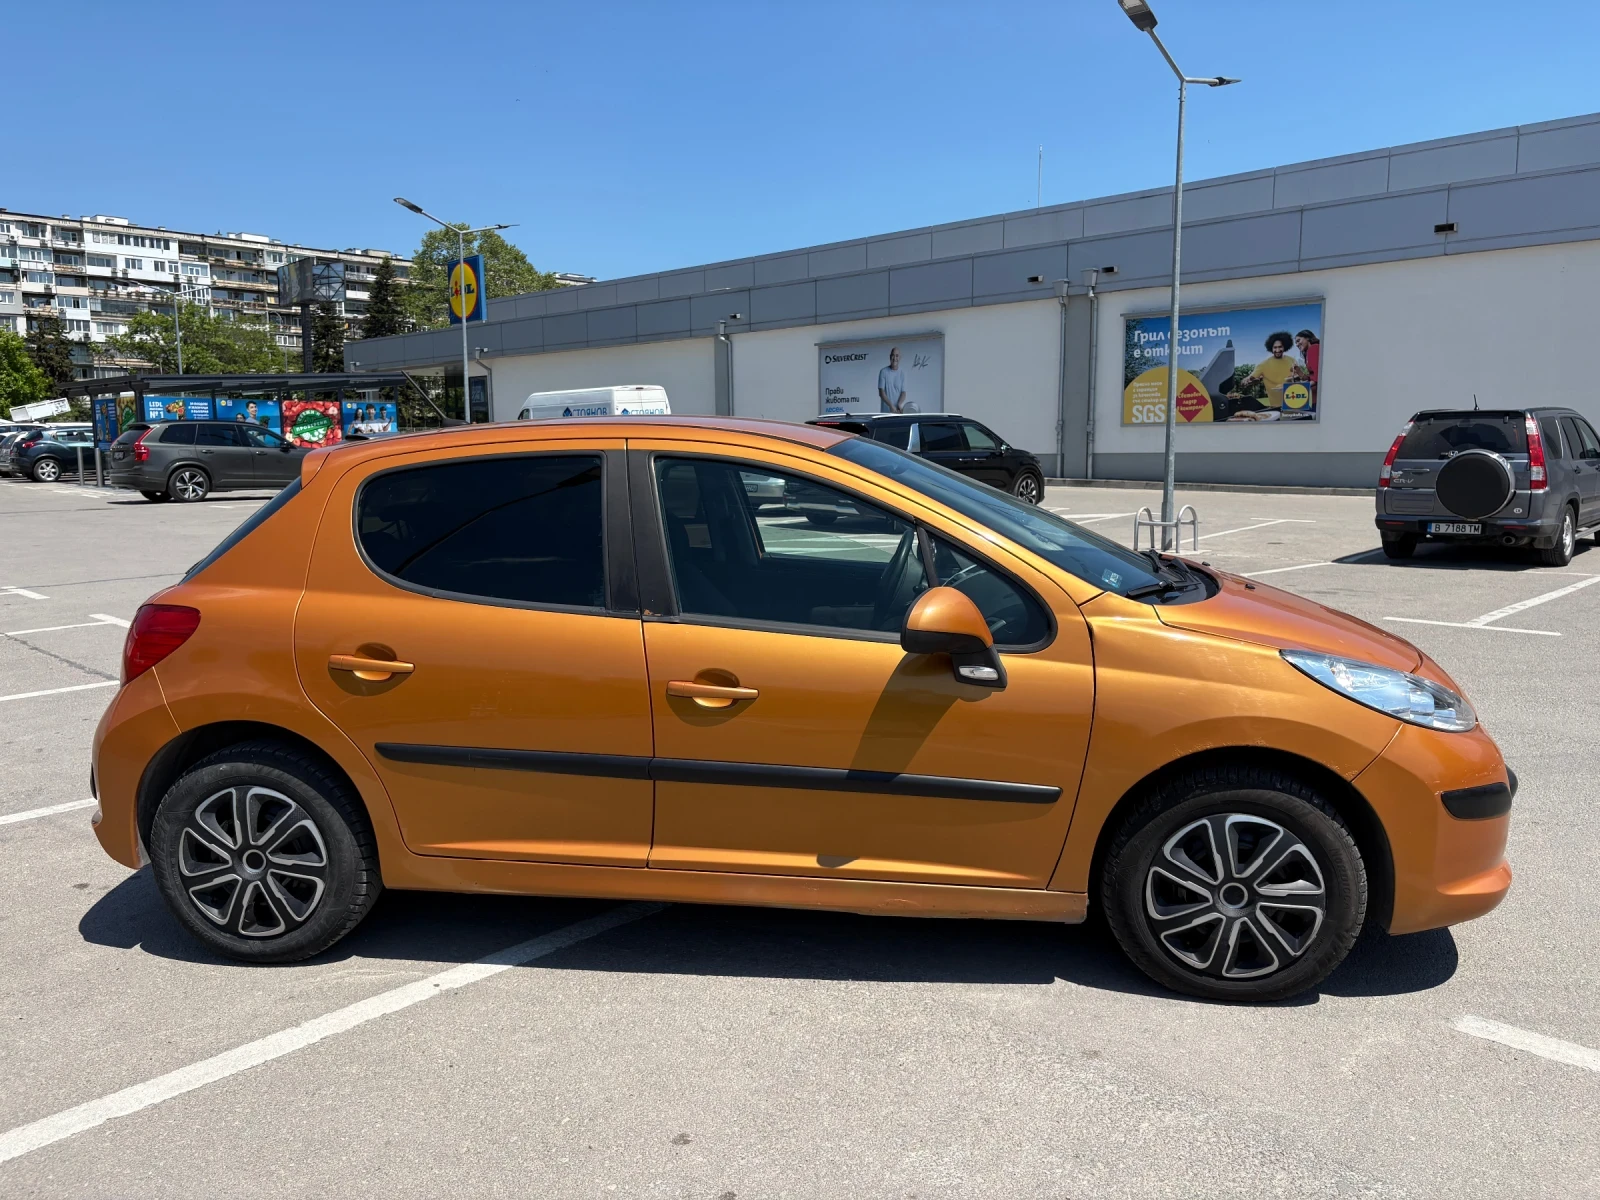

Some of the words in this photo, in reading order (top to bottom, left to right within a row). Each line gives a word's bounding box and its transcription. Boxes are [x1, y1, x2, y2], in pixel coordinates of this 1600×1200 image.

[1134, 329, 1165, 345] Грил
[1133, 348, 1141, 358] е
[825, 386, 844, 397] Прави
[825, 395, 850, 404] живота
[1131, 404, 1166, 424] SGS
[1444, 524, 1467, 533] 7188
